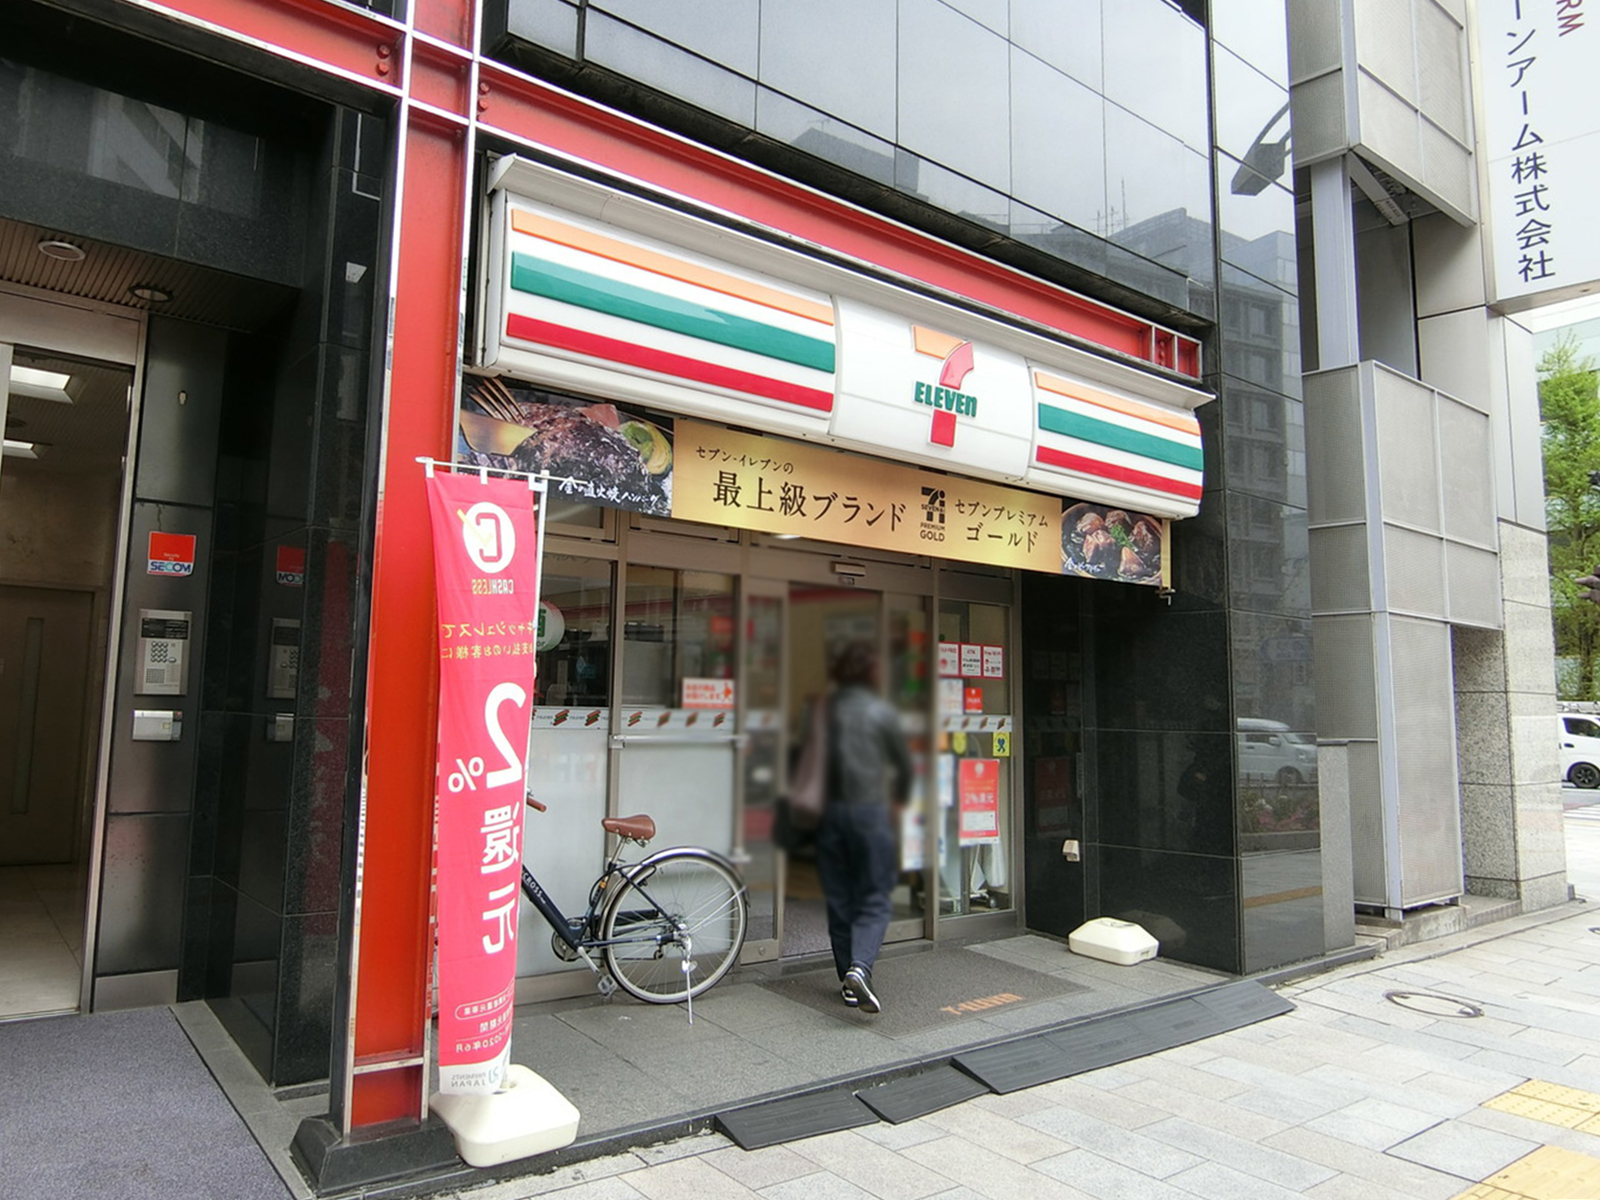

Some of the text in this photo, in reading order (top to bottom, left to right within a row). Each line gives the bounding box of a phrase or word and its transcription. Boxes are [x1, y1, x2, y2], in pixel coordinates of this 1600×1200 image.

[713, 470, 907, 532] 最上級ブランド
[955, 499, 1049, 528] セブンプレミアム
[920, 530, 945, 542] GOLD
[966, 522, 1038, 553] ゴールド
[150, 560, 192, 573] SECOM
